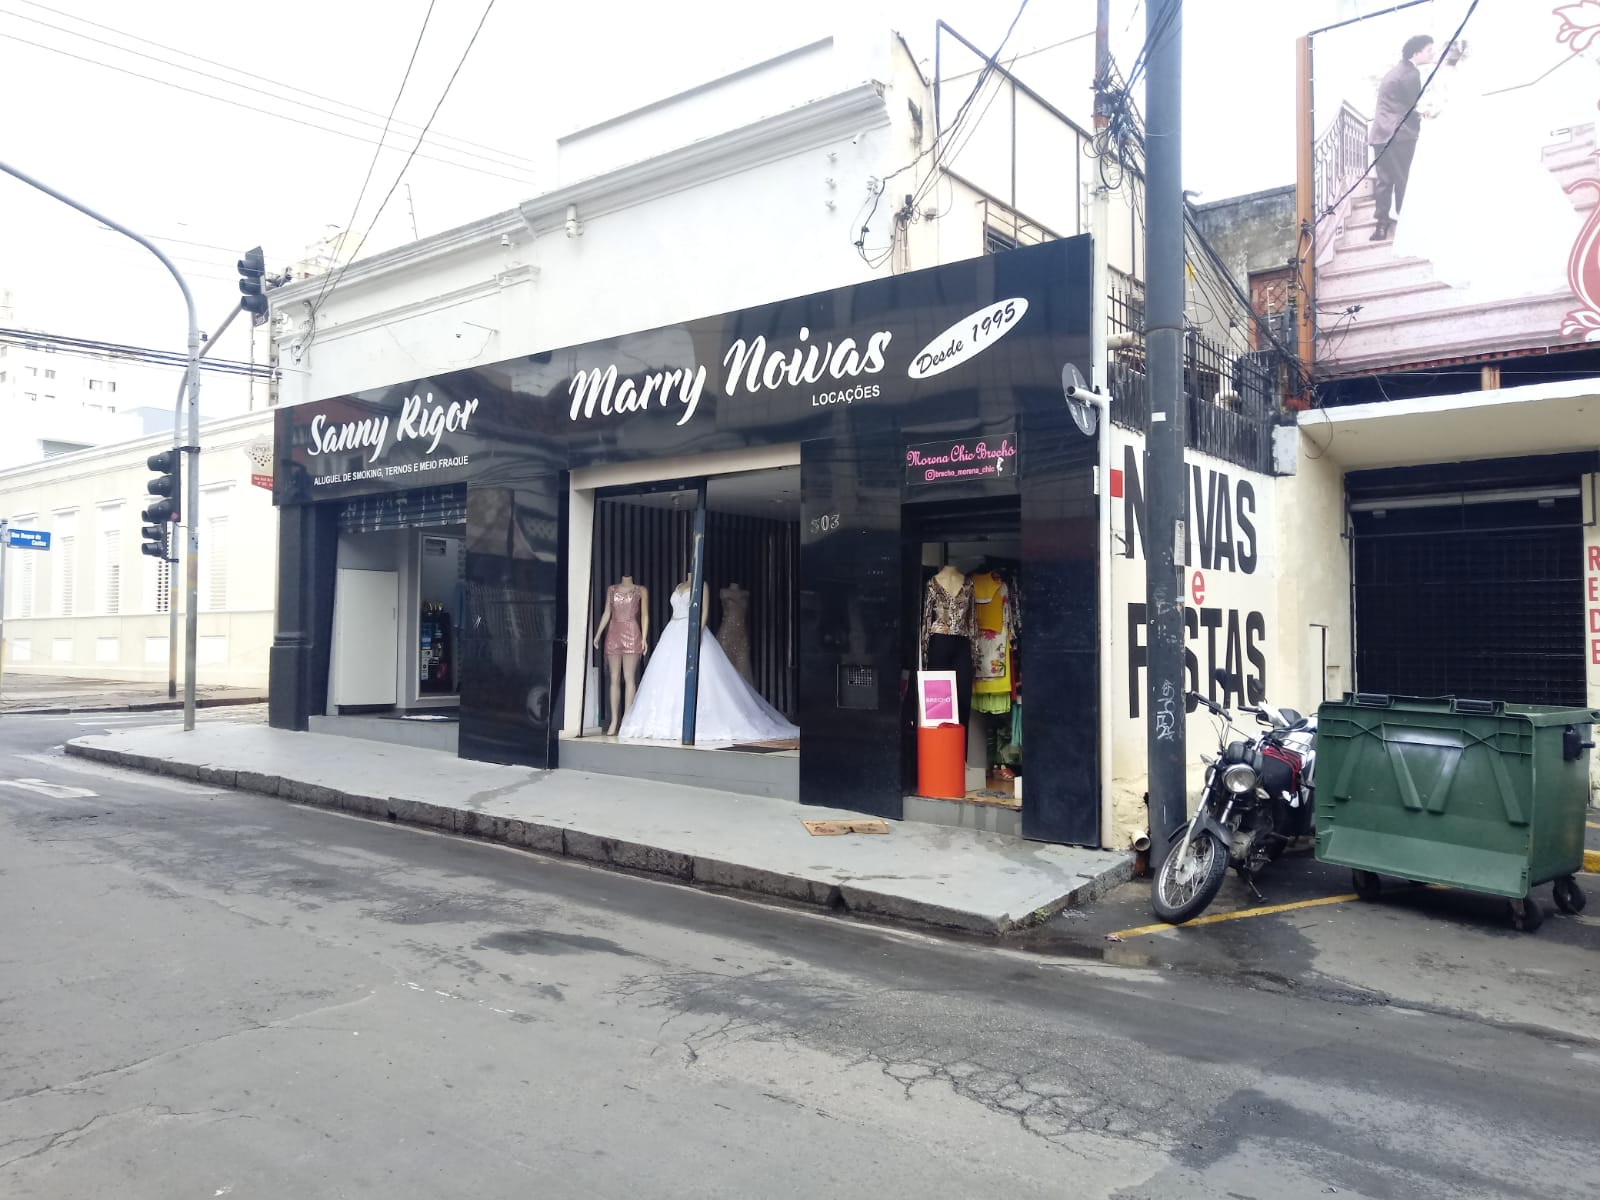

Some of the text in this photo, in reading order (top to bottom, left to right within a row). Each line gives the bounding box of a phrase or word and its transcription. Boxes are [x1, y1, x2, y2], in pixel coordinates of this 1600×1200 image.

[916, 301, 1016, 374] Desde 1995
[568, 326, 892, 426] Marry Noivas
[812, 385, 880, 406] LOCAÇÕES
[307, 392, 479, 463] Sanny Rigor
[906, 450, 949, 467] Morena
[950, 444, 976, 462] Chic
[313, 455, 469, 486] ALUGUEL DE SMOKING, TERNOS E MEIO FRAQUE
[1124, 445, 1258, 575] NIVAS
[1191, 570, 1206, 606] e
[1127, 602, 1267, 719] FSTAS
